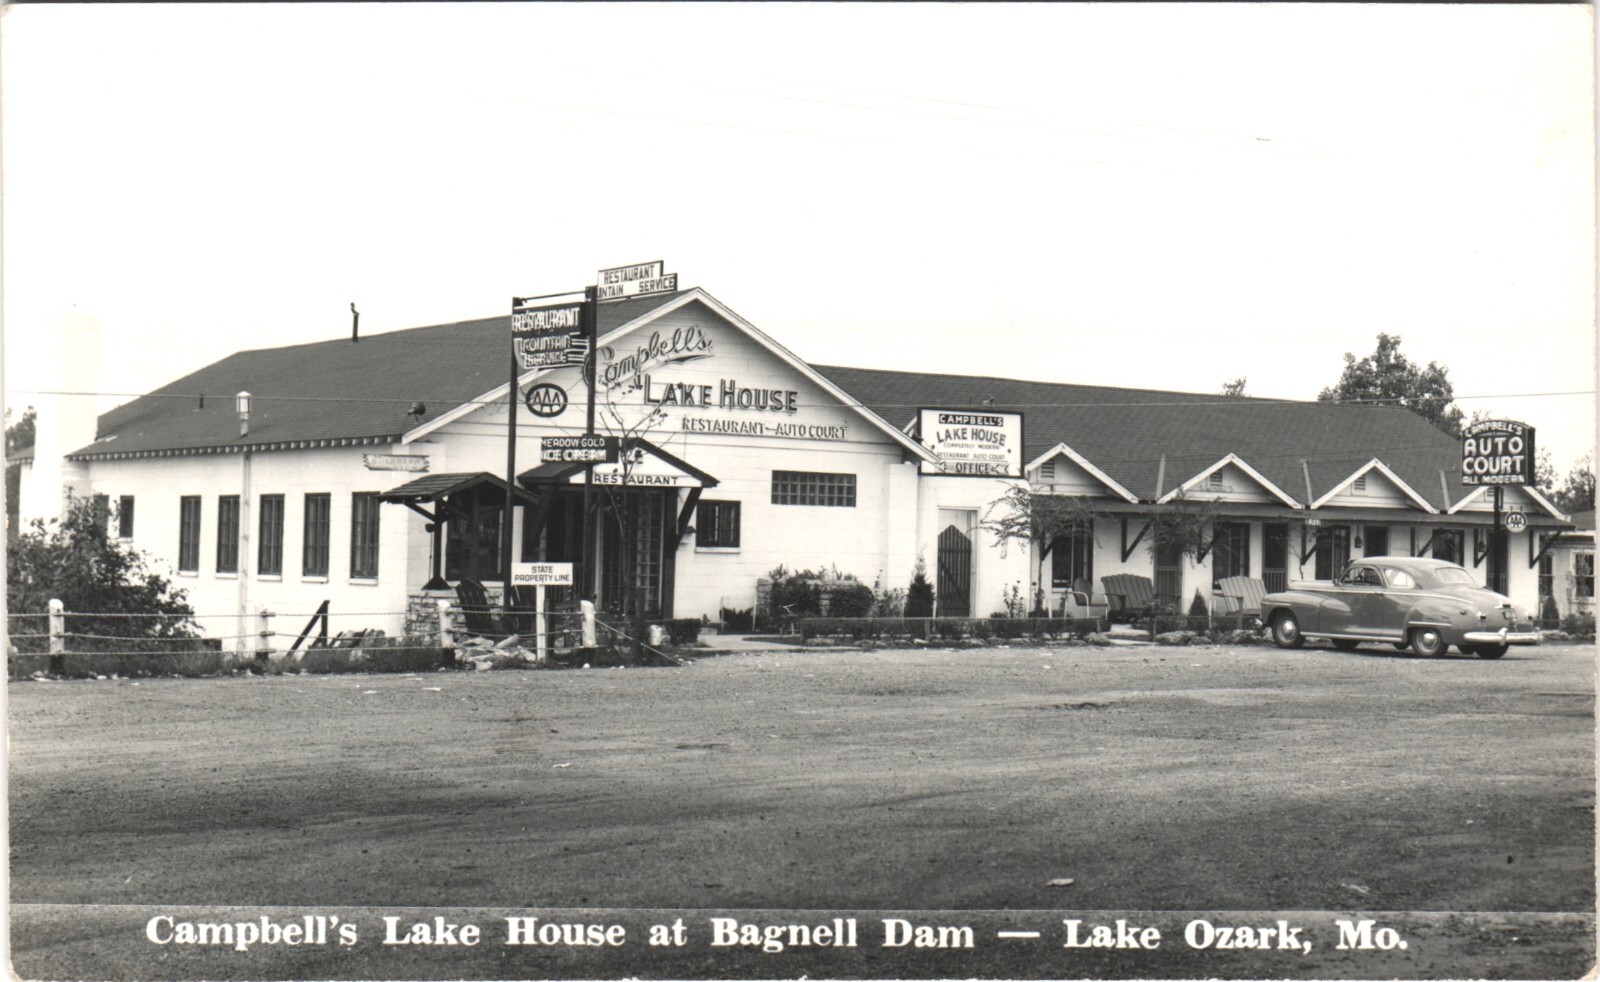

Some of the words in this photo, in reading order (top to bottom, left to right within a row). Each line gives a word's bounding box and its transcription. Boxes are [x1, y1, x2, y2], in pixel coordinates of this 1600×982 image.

[604, 265, 654, 285] RESTAURANT
[597, 285, 623, 298] UNTAIN
[639, 276, 674, 293] SERVICE
[512, 307, 580, 332] RESTAURANT
[522, 335, 571, 353] FOUNTAIN
[526, 352, 567, 366] SERVICE
[583, 325, 713, 389] Campbell's
[532, 387, 562, 413] AAA
[643, 374, 713, 406] LAKE
[720, 379, 798, 412] HOUSE
[939, 415, 1003, 426] CAMPBELL'S
[1464, 421, 1523, 437] CAMPBELL'S
[809, 425, 848, 439] COURT
[936, 428, 968, 443] LAKE
[971, 428, 1007, 447] HOUSE
[540, 438, 580, 448] MEADOW
[581, 437, 606, 448] GOLD
[1464, 436, 1524, 457] AUTO
[563, 449, 607, 462] CREAM
[955, 463, 989, 474] OFFICE
[1462, 455, 1525, 475] COURT
[1462, 475, 1479, 484] ALL
[1482, 475, 1525, 484] MODERN
[514, 574, 553, 582] PROPERTY
